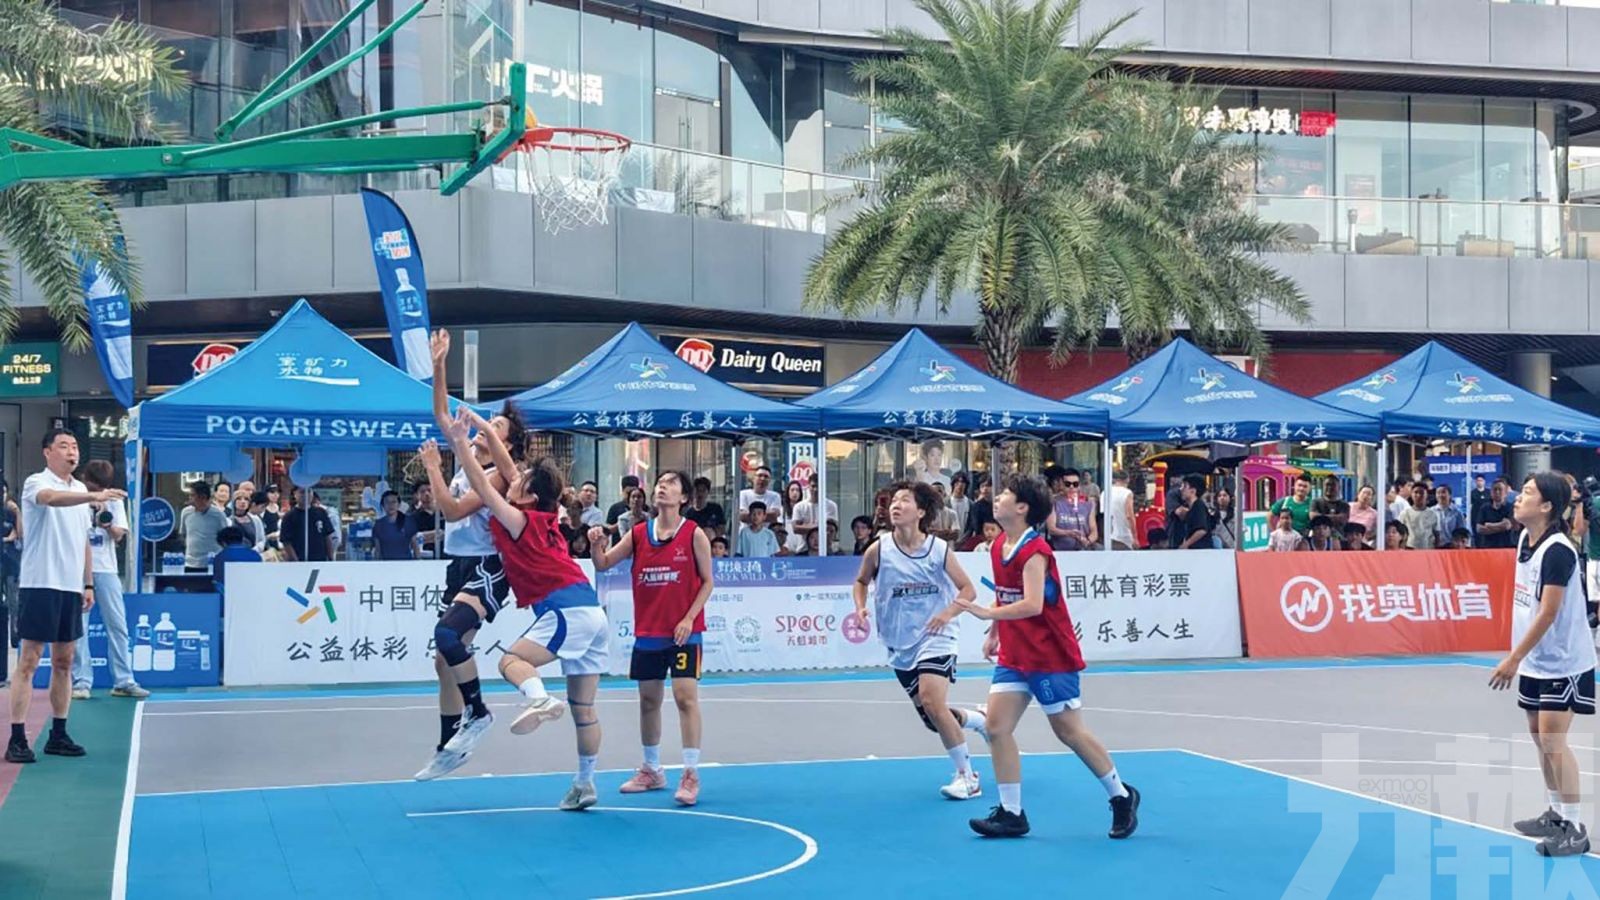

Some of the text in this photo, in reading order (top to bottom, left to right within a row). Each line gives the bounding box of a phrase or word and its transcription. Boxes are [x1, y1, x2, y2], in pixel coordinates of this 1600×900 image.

[3, 364, 52, 374] FITNESS
[13, 354, 42, 364] 24/7
[278, 356, 348, 368] 宝矿力
[720, 348, 822, 373] Dairy Queen
[206, 415, 432, 440] POCARI SWEAT
[572, 411, 760, 430] 公益体彩 乐善人生
[882, 408, 1052, 427] 公益体彩 乐善人生
[1165, 422, 1328, 440] 公益体彩 乐善人生
[1438, 420, 1587, 443] 公益体彩 乐善人生
[359, 583, 447, 612] 中国体
[1065, 573, 1191, 599] 国体育彩票
[1338, 582, 1493, 623] 我奥体育
[1097, 619, 1194, 643] 乐善人生
[286, 635, 409, 663] 公益体彩
[676, 653, 688, 670] 3
